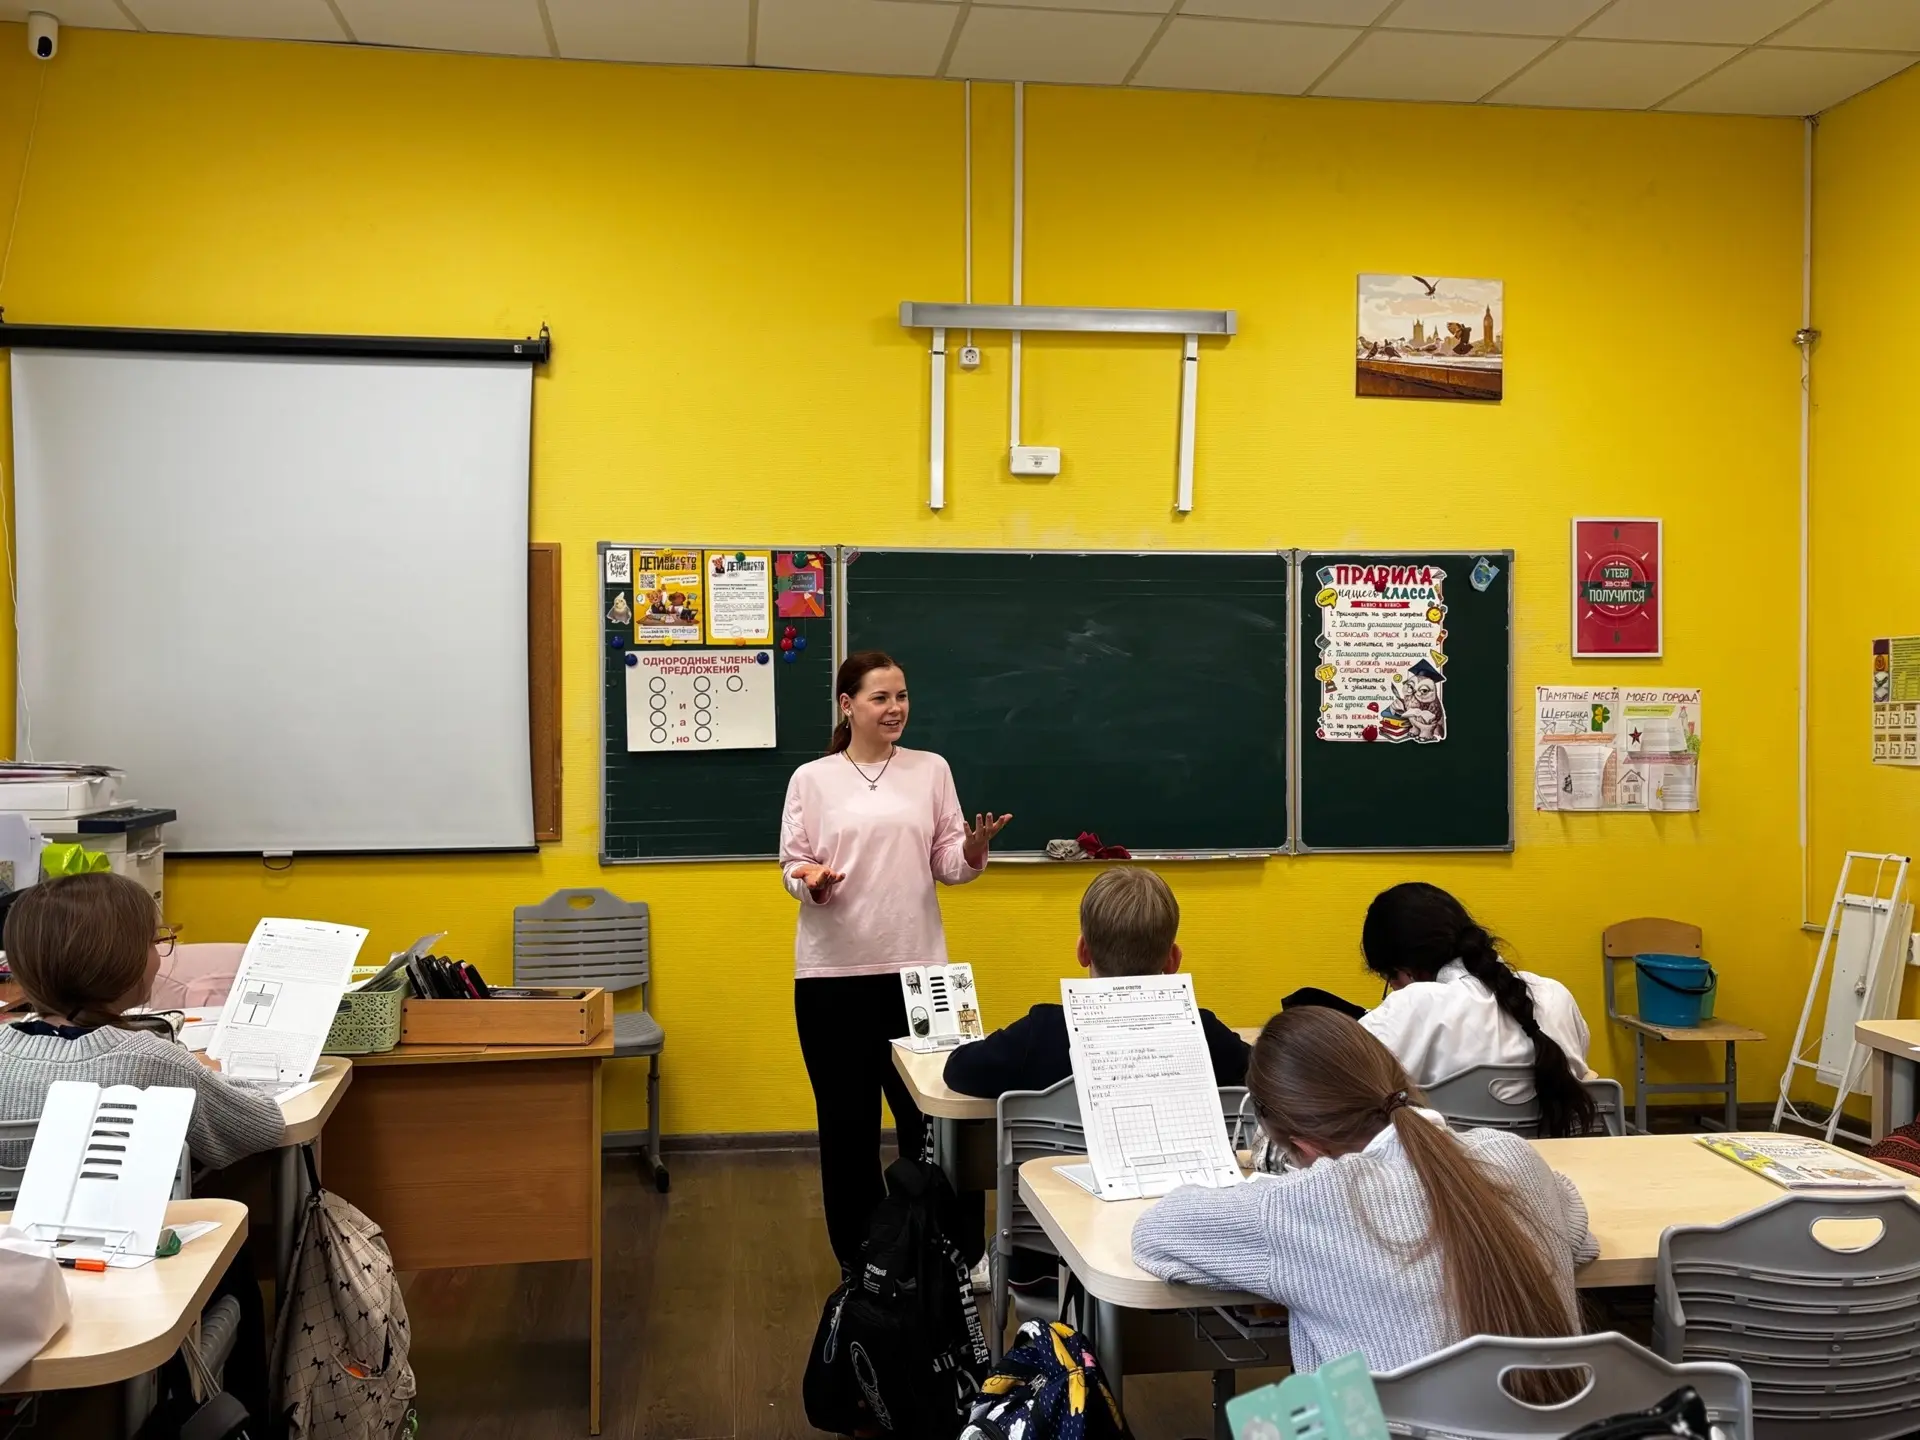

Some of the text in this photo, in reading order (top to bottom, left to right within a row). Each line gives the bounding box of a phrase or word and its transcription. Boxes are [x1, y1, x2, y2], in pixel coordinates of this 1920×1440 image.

[639, 556, 664, 571] ДЕТИ
[1336, 566, 1433, 586] ПРАВИЛА
[1604, 568, 1629, 578] У ТЕБЯ
[1338, 587, 1436, 600] нашего КЛАССА
[1589, 589, 1646, 602] ПОЛУЧИТСЯ
[1382, 611, 1397, 619] урок
[1339, 620, 1366, 628] Делать
[1367, 621, 1403, 630] домашние
[1336, 649, 1370, 657] Помогать
[643, 656, 757, 666] ОДНОРОДНЫЕ ЧЛЕНЫ
[660, 666, 740, 675] ПРЕДЛОЖЕНИЯ
[1357, 693, 1395, 701] активным
[1539, 688, 1698, 703] ПАМЯТНЫЕ МЕСТА МОЕГО ГОРОДА
[1541, 707, 1589, 719] ЩЕРБИНКА
[676, 736, 690, 744] но
[965, 1316, 984, 1365] EDITION
